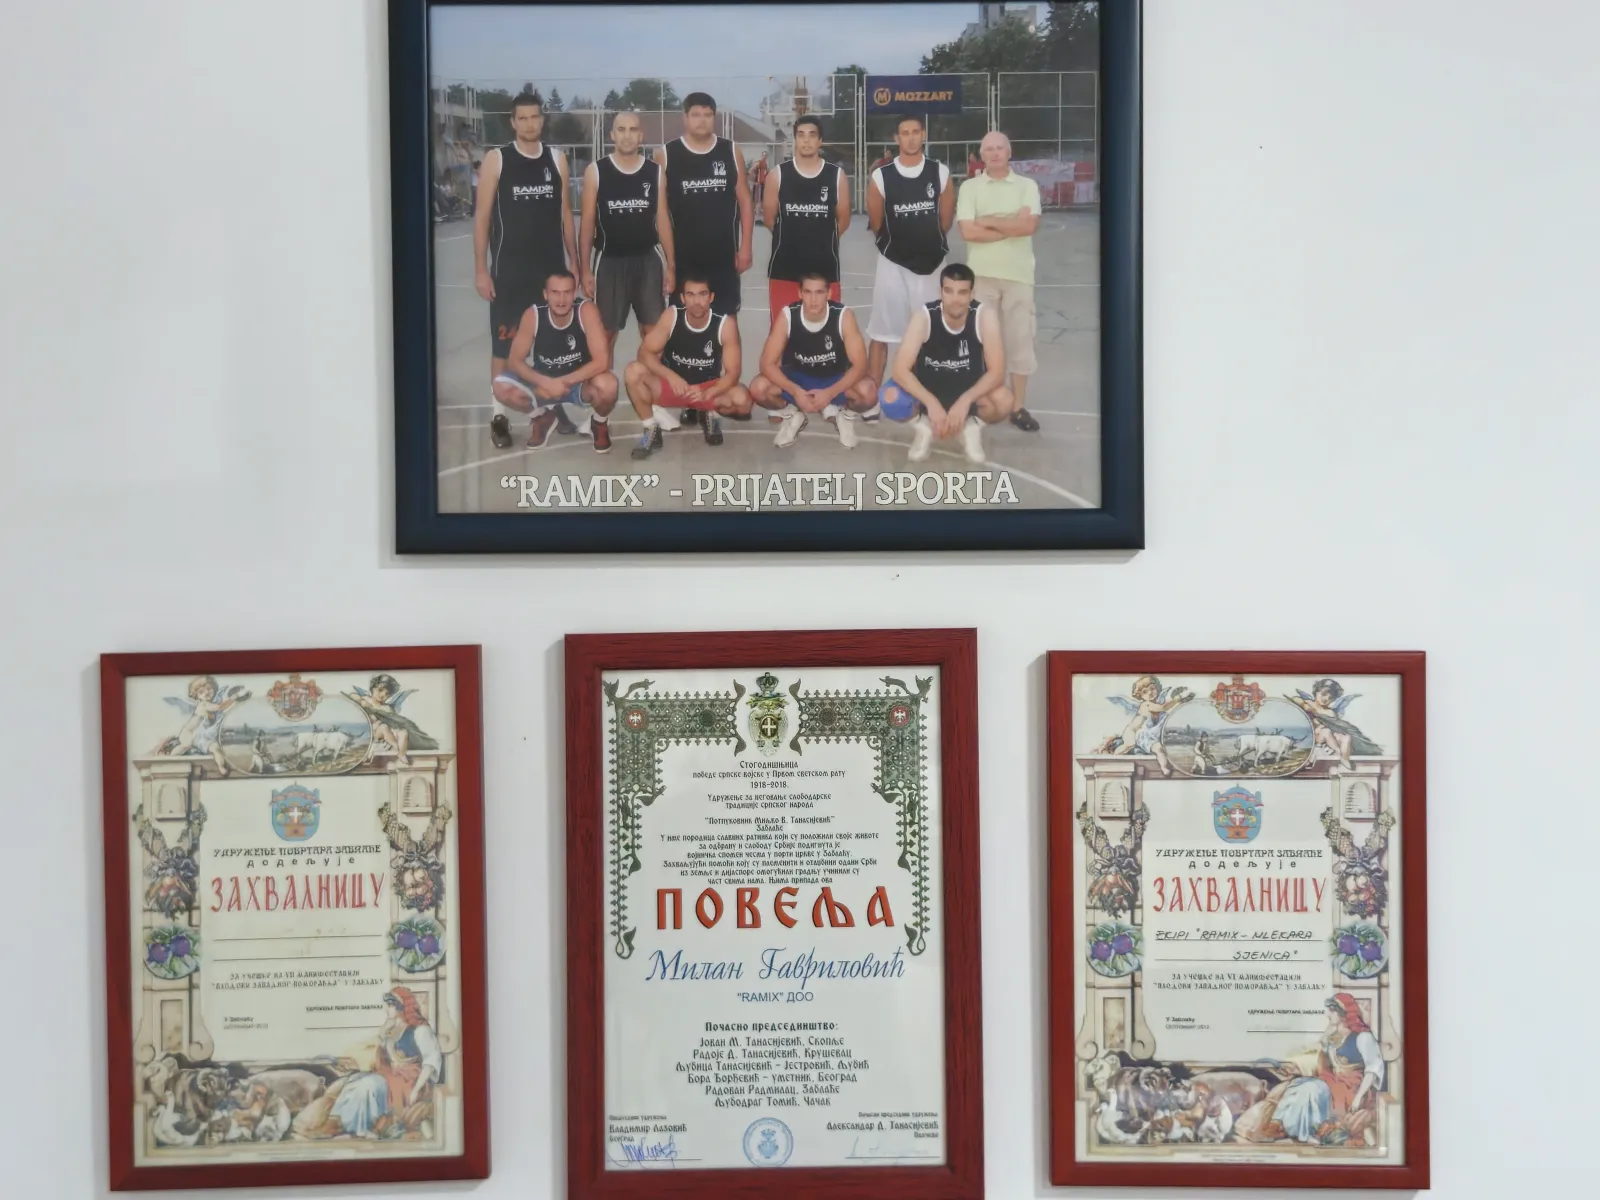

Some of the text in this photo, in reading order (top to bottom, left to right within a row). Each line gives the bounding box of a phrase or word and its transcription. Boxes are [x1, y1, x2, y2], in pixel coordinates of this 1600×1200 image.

[895, 91, 953, 101] MOZZART
[713, 161, 726, 176] 12
[643, 183, 651, 198] 7
[927, 182, 934, 198] 6
[568, 334, 576, 350] 9
[704, 340, 713, 356] 4
[824, 334, 832, 350] 8
[691, 472, 866, 512] PRIJATELJ
[875, 471, 1020, 505] SPORTA
[214, 848, 276, 857] УДРУЖЕЊЕ
[1156, 849, 1218, 858] УДРУЖЕЊЕ
[211, 872, 385, 912] ЗАХВАЛНИЦУ
[1153, 876, 1327, 912] ЗАХВАЛНИЦУ
[656, 886, 895, 930] ПОВЕЉА
[645, 946, 905, 990] Милан Гавриловић
[786, 992, 814, 1003] ДОО
[705, 1022, 748, 1032] Почасно
[700, 1037, 726, 1047] Јован
[808, 1036, 844, 1046] Скопље
[693, 1049, 724, 1060] Радоје
[804, 1048, 852, 1059] Крушевац
[676, 1062, 713, 1072] Љубица
[716, 1061, 772, 1072] Танасијевић
[838, 1060, 869, 1071] Љубић
[688, 1074, 711, 1084] Бора
[714, 1073, 759, 1084] Ђорђевић
[818, 1072, 857, 1084] Београд
[705, 1085, 745, 1095] Радован
[803, 1084, 840, 1094] Заблаће
[715, 1098, 763, 1108] Љубодраг
[804, 1096, 830, 1106] Чачак
